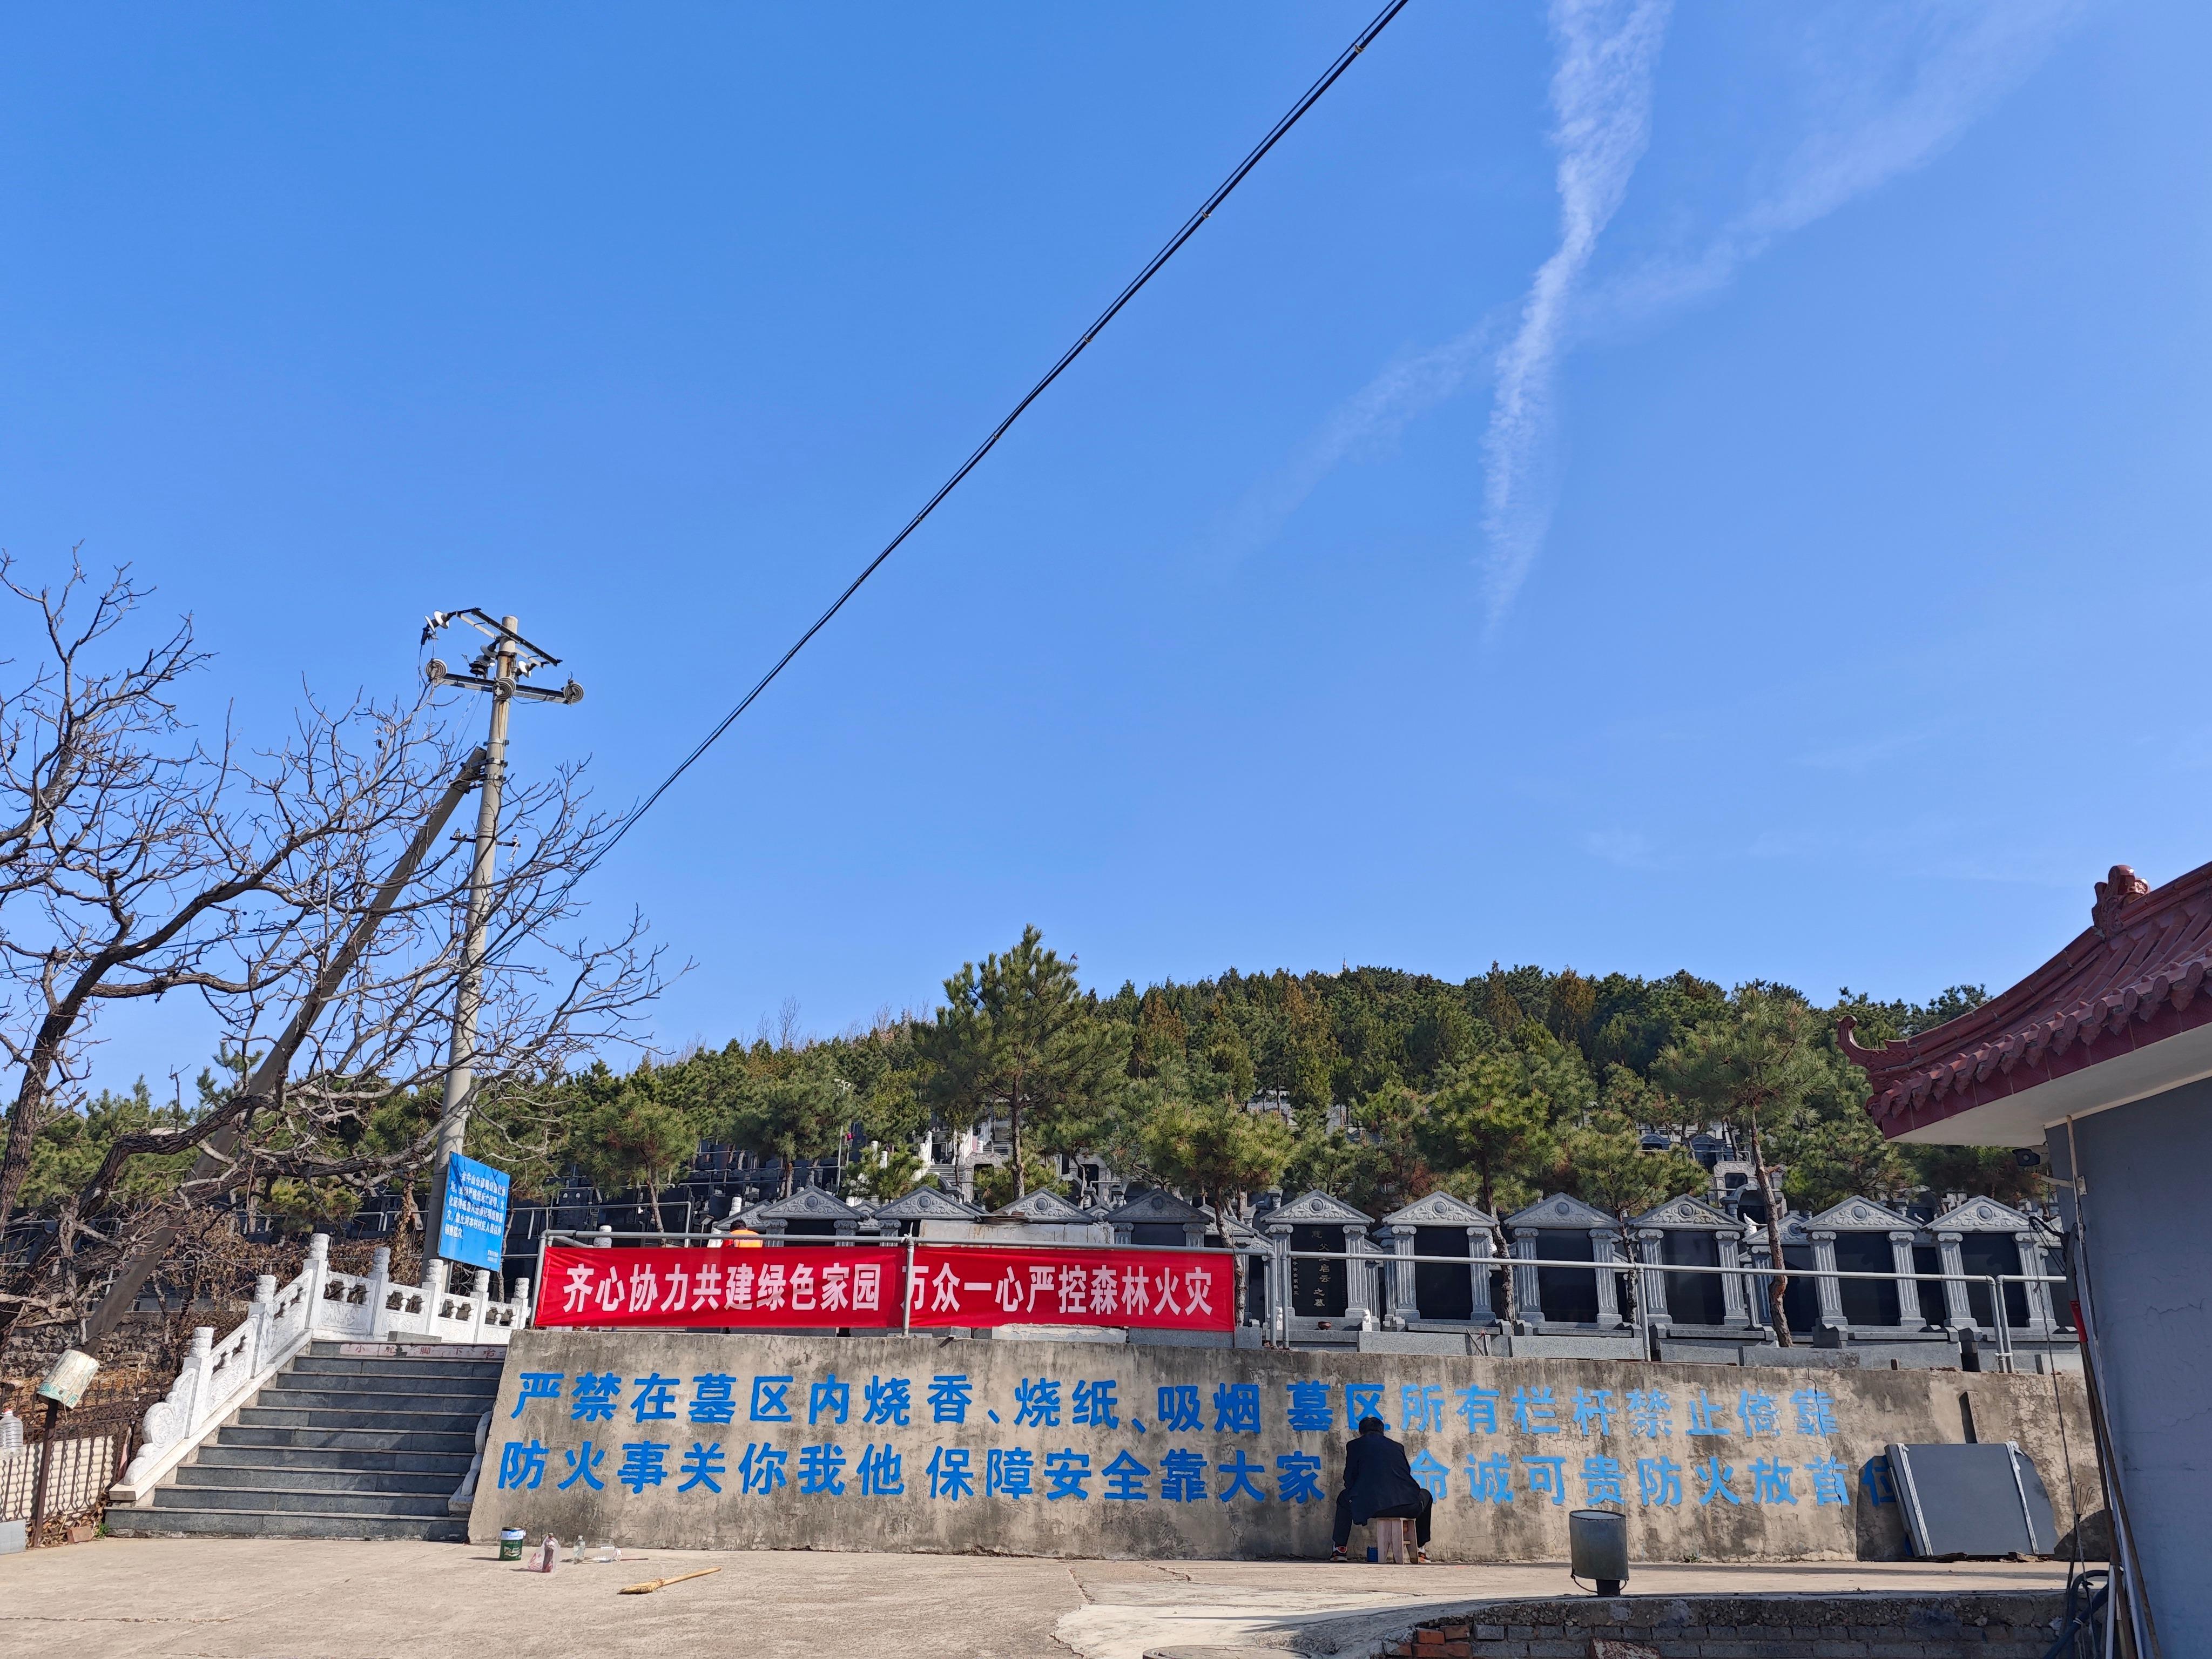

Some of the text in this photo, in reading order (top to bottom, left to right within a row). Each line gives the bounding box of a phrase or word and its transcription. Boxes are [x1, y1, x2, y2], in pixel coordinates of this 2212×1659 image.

[563, 1263, 881, 1312] 齐心协力共建绿色家园
[900, 1262, 1213, 1316] 万众一心严控森林火灾
[510, 1372, 1839, 1438] 严禁在墓区内烧香、烧纸、吸烟 墓区所有栏杆禁止倚靠
[497, 1440, 1897, 1507] 防火事关你我他 保障安全靠大家 命诚可贵防火放首位
